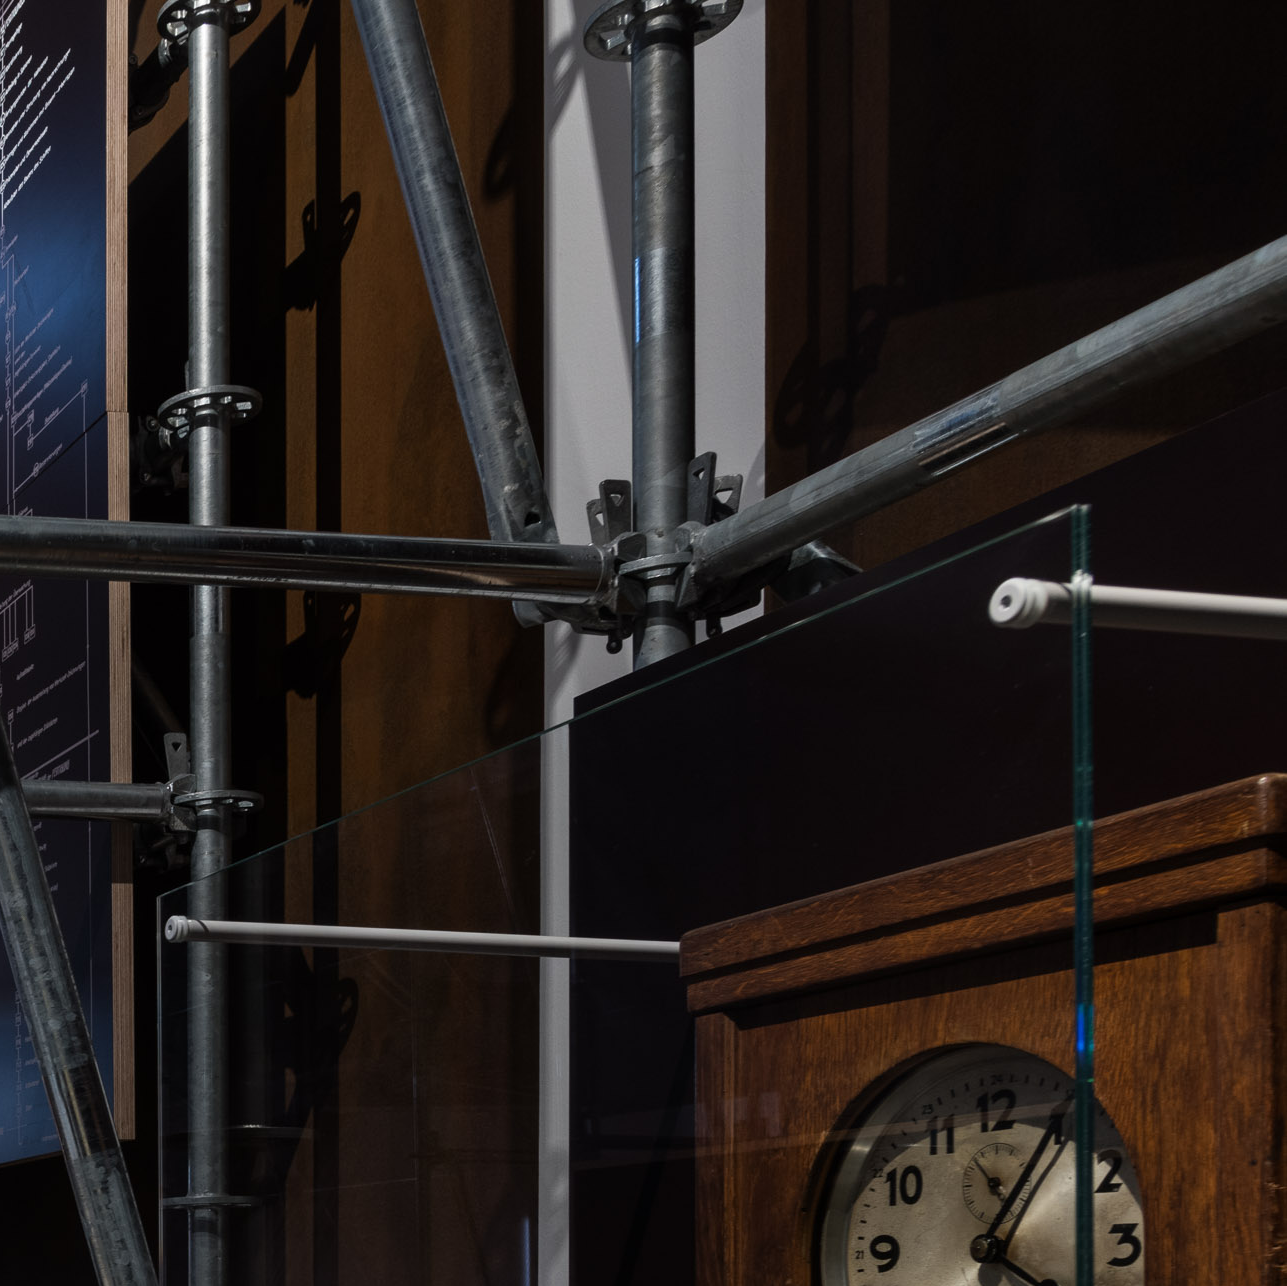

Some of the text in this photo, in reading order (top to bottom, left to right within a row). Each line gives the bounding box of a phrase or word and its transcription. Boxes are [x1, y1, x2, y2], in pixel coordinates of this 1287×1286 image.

[976, 1089, 1016, 1132] 12
[928, 1113, 955, 1155] 11
[885, 1165, 924, 1206] 10
[1094, 1149, 1123, 1194] 2
[869, 1234, 901, 1273] 9
[1106, 1223, 1142, 1267] 3
